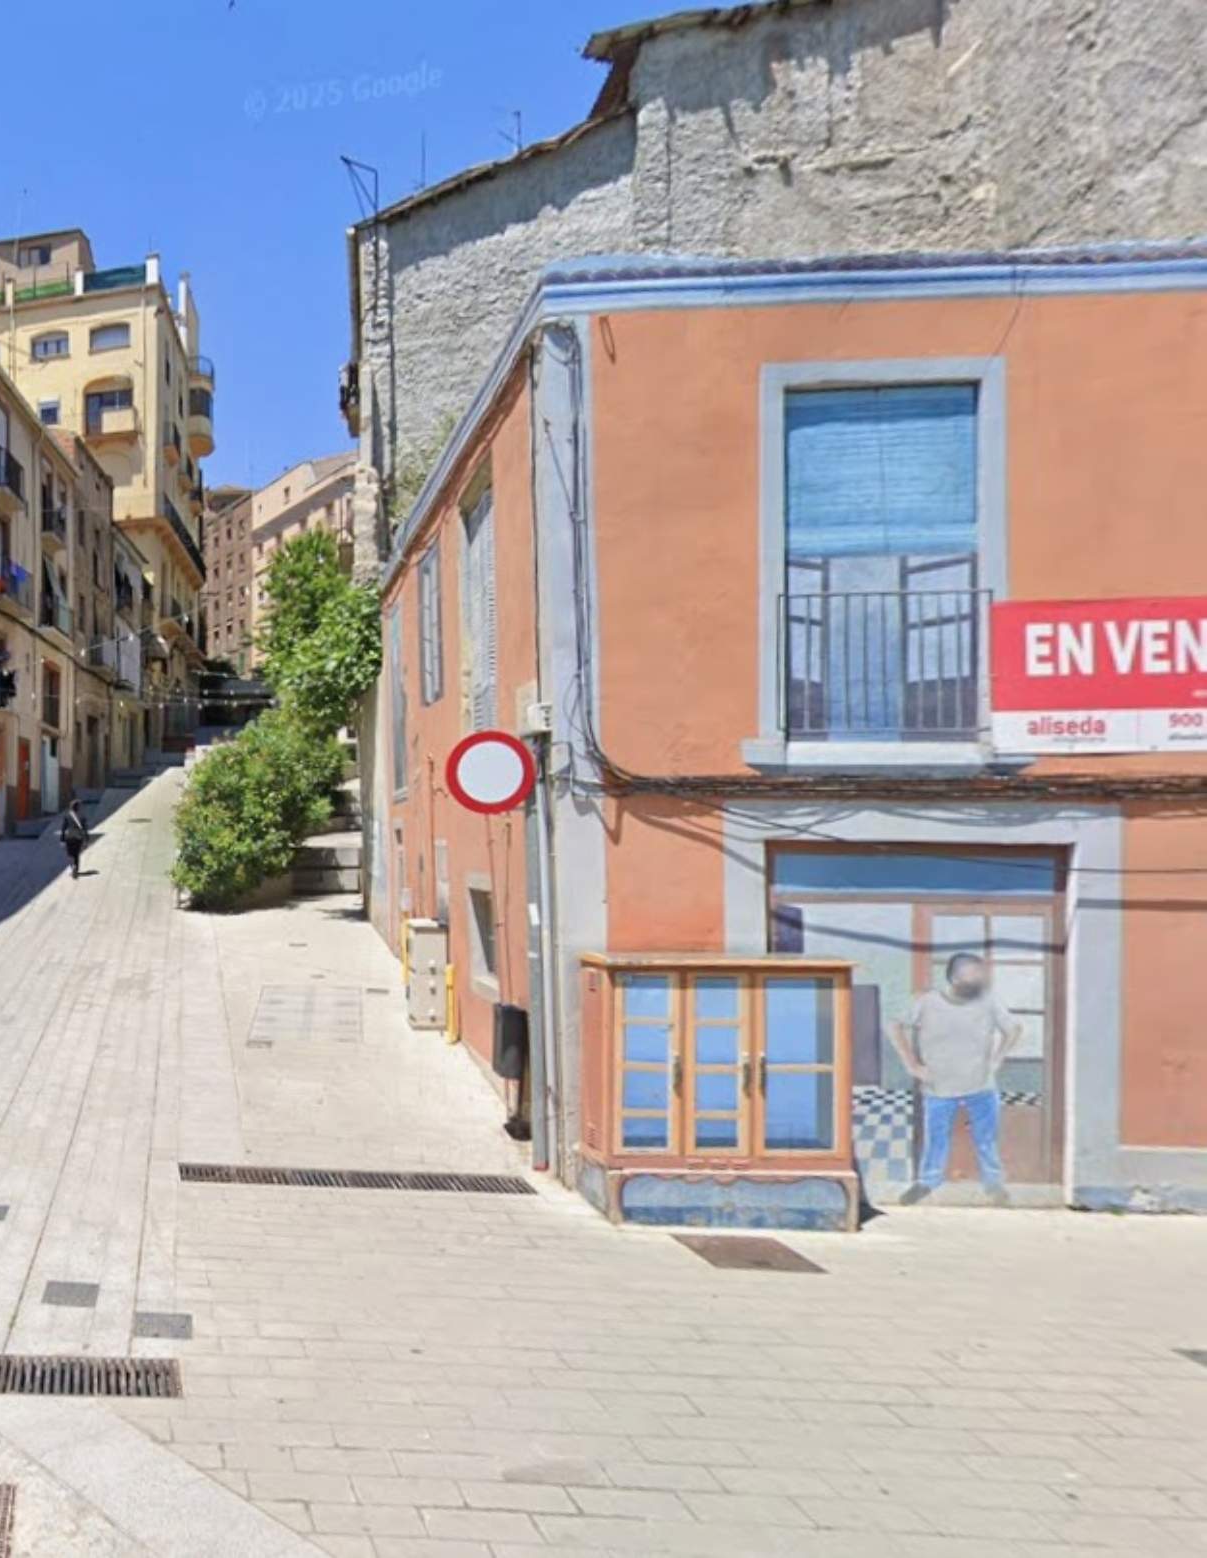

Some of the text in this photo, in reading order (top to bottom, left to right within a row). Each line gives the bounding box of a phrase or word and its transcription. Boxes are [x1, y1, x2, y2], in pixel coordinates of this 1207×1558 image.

[1025, 619, 1207, 676] EN VEN
[1027, 717, 1106, 736] aliseda
[1168, 713, 1203, 728] 900
